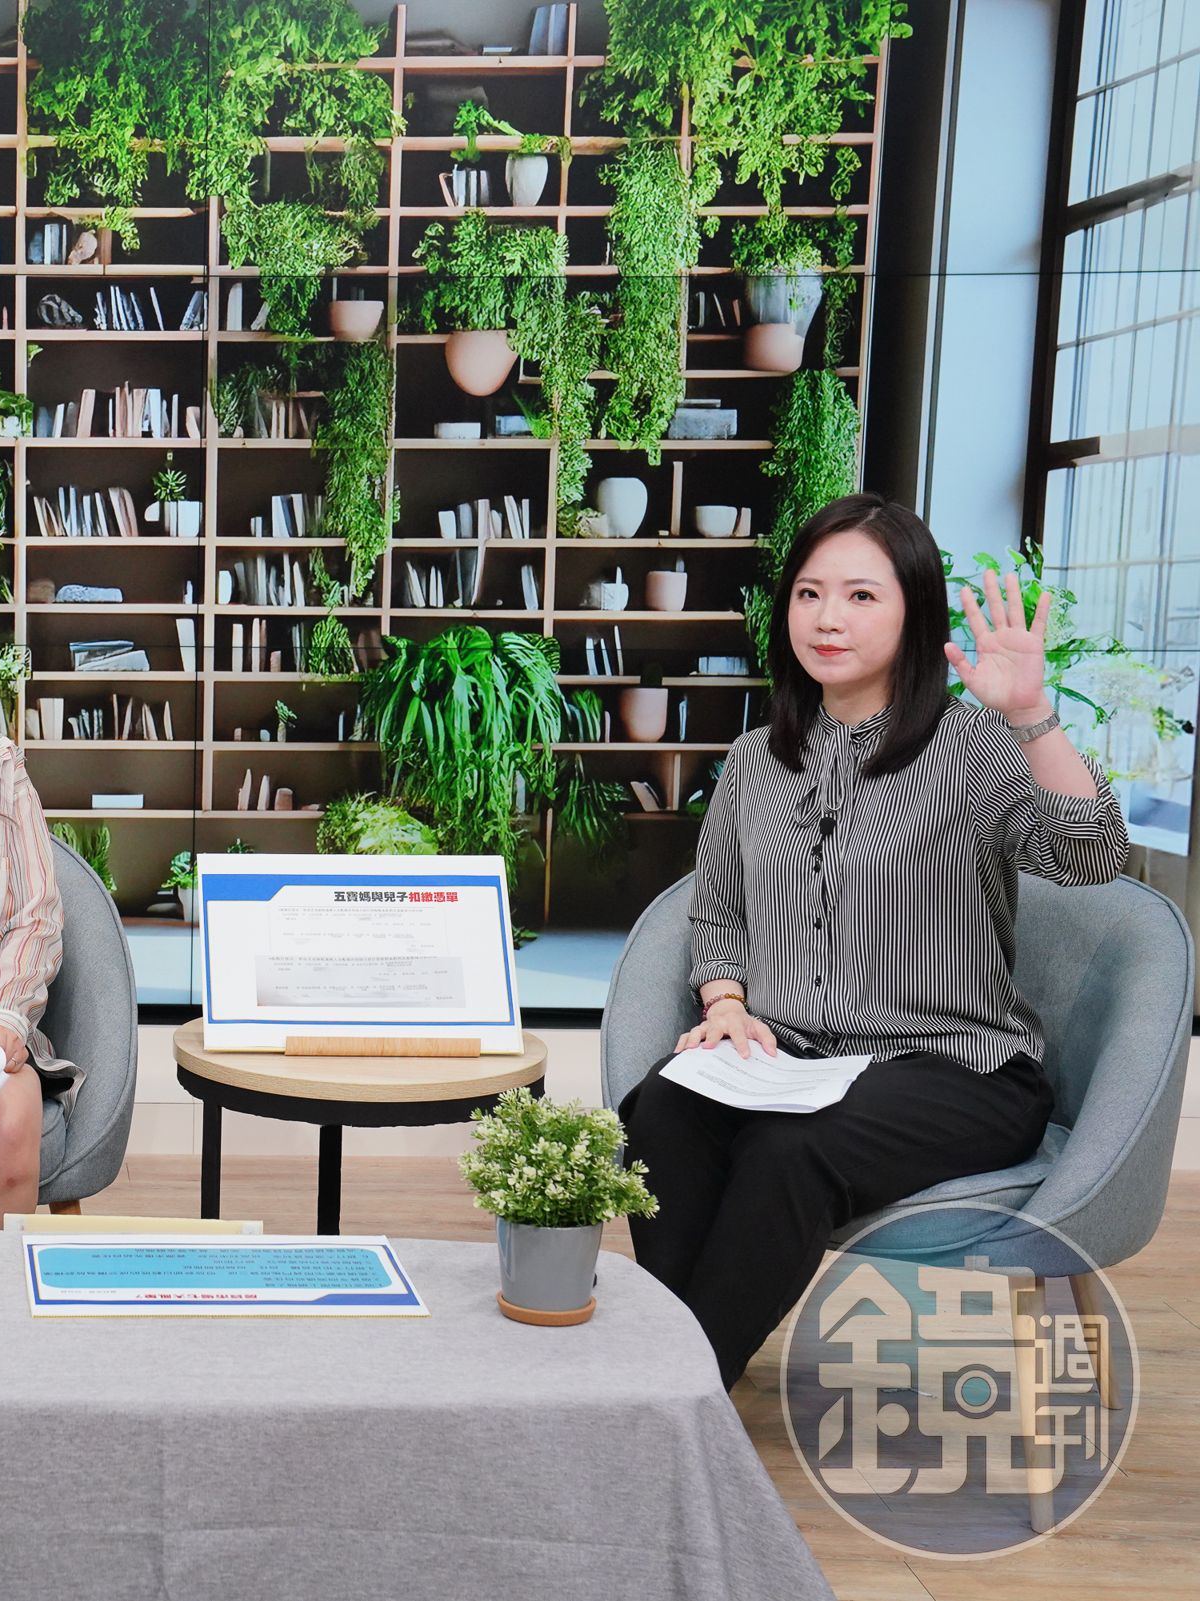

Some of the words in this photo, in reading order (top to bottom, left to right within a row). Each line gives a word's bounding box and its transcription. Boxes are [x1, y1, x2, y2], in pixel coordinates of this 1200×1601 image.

[333, 891, 459, 903] 五寶媽與兒子扣繳憑單
